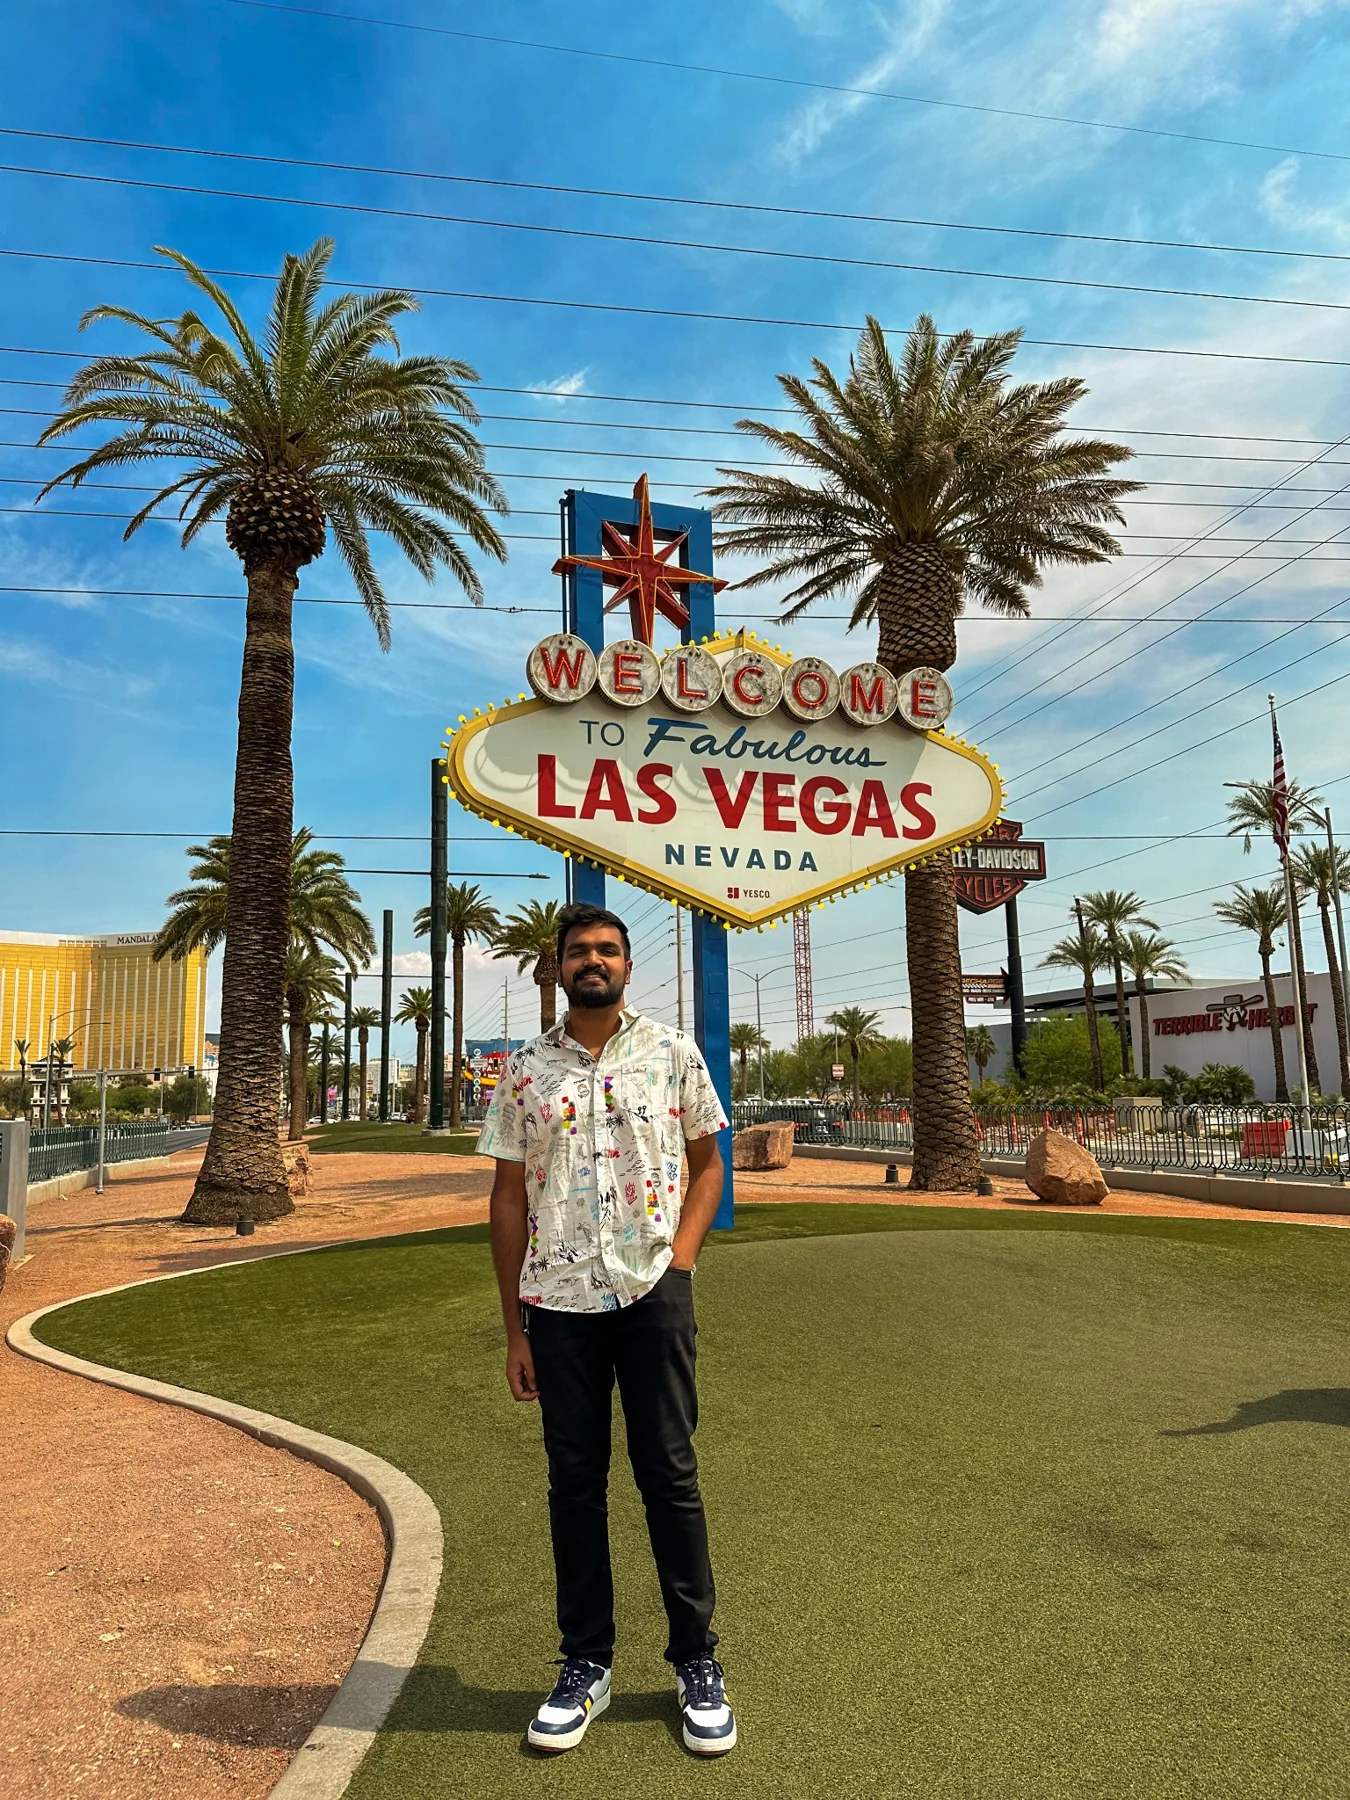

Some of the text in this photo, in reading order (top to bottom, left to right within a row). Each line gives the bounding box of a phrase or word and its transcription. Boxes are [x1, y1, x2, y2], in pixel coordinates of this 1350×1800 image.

[539, 646, 937, 718] WELCOME
[579, 717, 888, 768] TO Fabulous
[537, 753, 937, 841] LAS VEGAS
[664, 843, 818, 872] NEVADA
[951, 846, 1039, 870] LEY-DAVIDSON
[743, 889, 771, 899] YESCO
[1152, 1003, 1318, 1036] TERRIBLE HERBT
